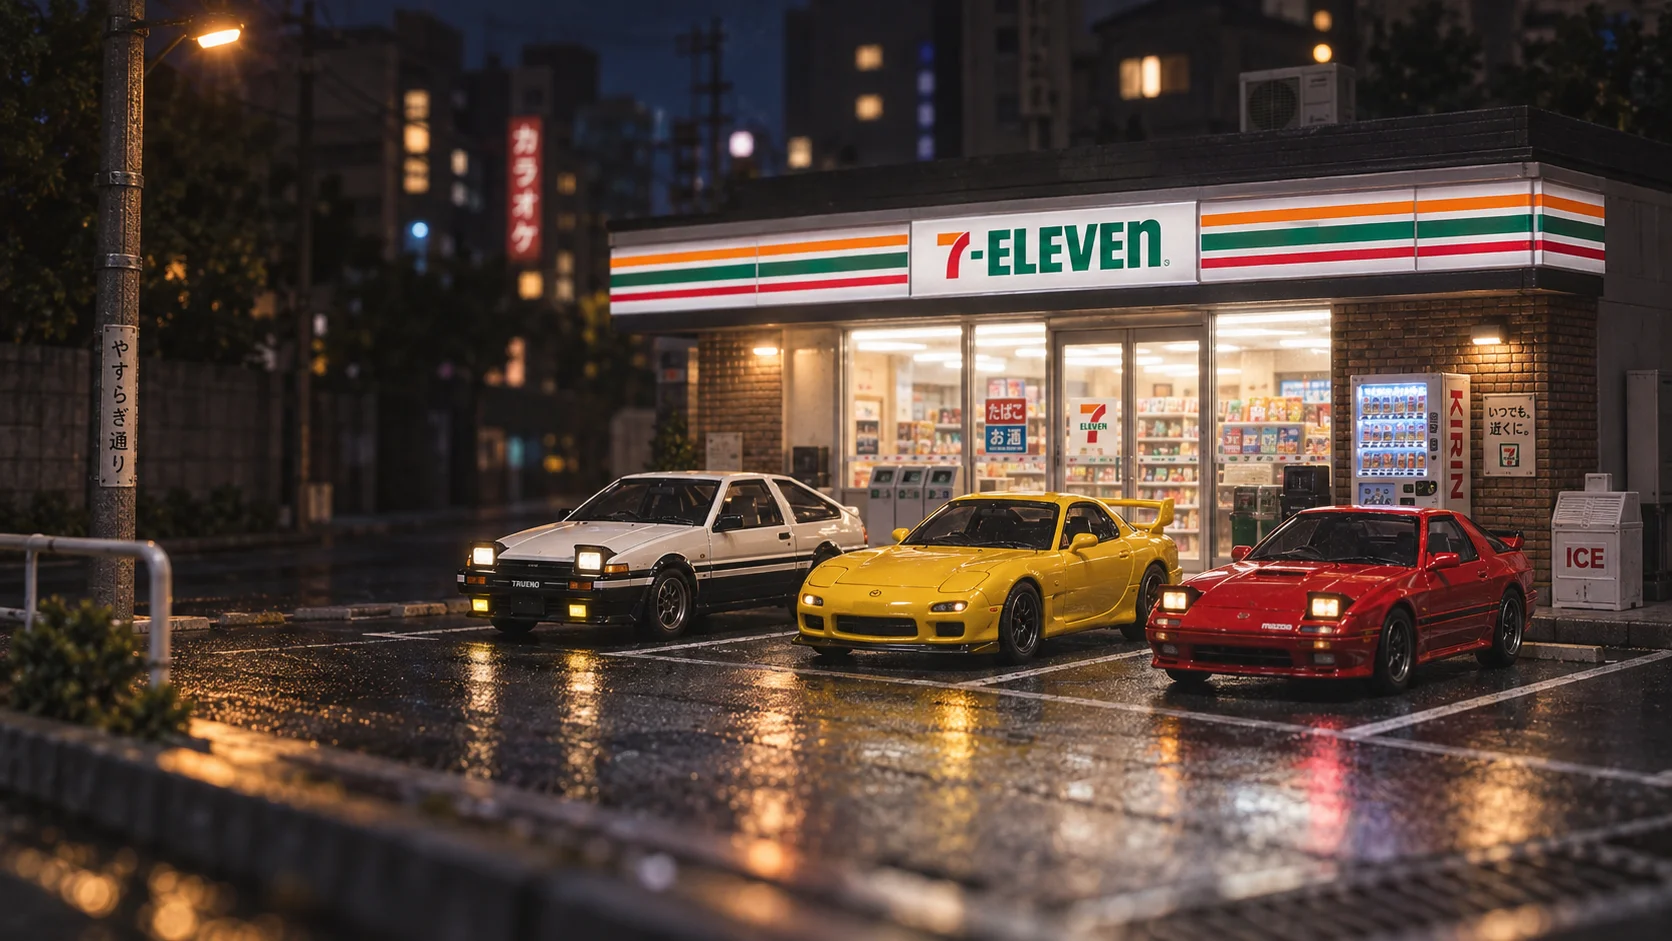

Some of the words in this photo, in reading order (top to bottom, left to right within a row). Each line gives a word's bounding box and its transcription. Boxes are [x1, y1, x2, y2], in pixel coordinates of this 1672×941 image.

[511, 123, 539, 253] カラオケ
[109, 339, 129, 473] やすらぎ通り
[989, 403, 1023, 420] たばこ
[1488, 405, 1531, 419] いつでも、
[1080, 404, 1106, 443] 7
[1489, 421, 1530, 436] 近くに。
[990, 428, 1021, 445] お酒
[1450, 390, 1464, 499] KIRIN
[1566, 547, 1605, 569] ICE
[512, 580, 539, 588] TRUENO
